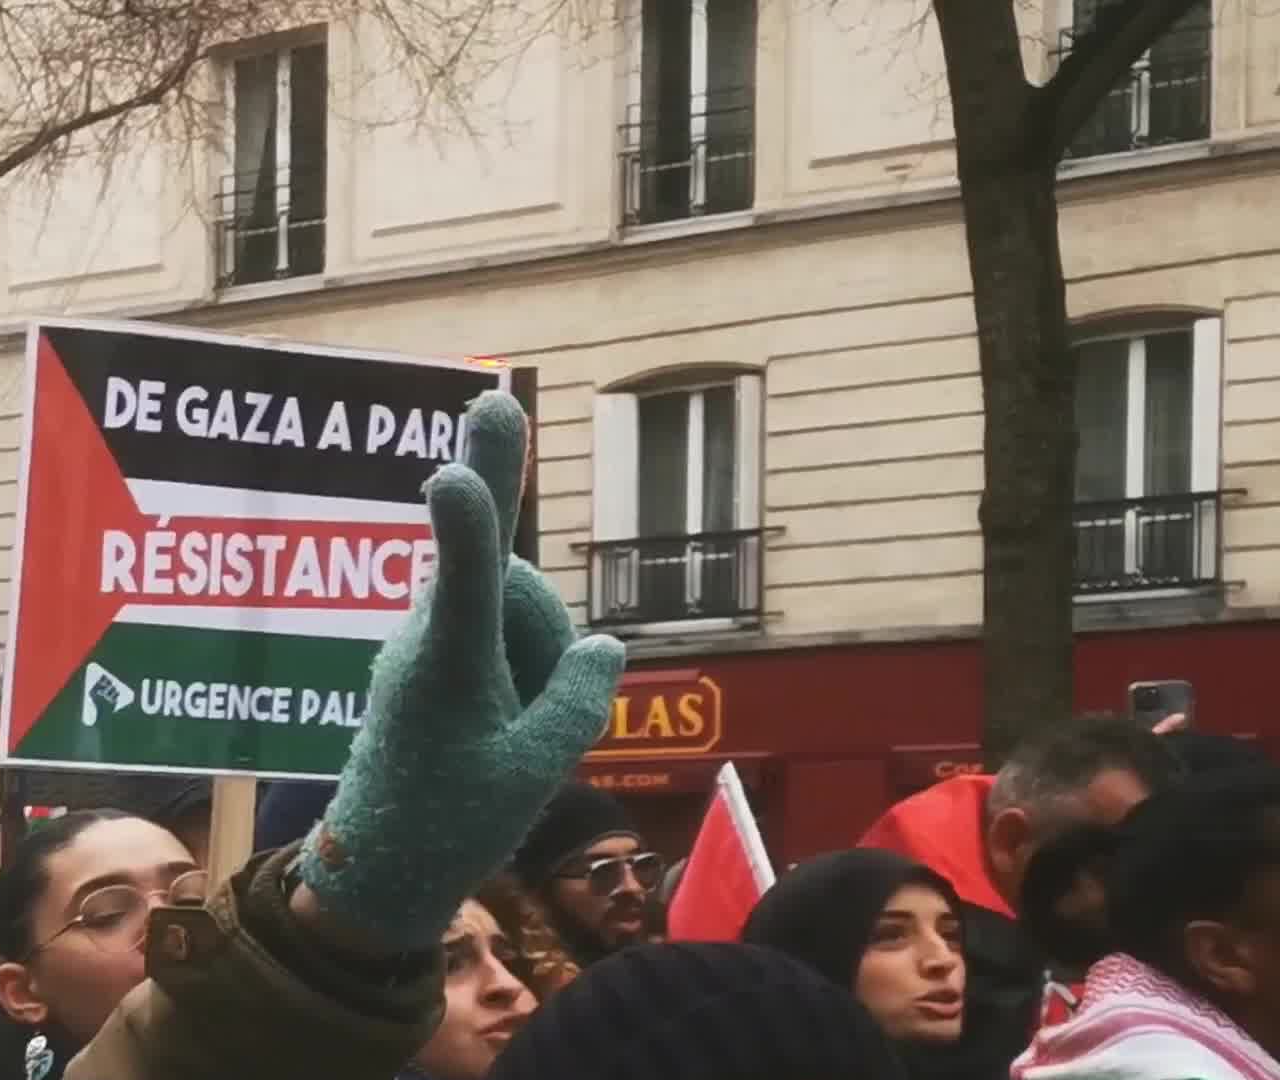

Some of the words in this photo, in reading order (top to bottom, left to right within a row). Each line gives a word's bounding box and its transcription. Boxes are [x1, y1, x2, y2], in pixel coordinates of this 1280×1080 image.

[104, 375, 166, 433] DE
[176, 385, 304, 449] GAZA
[316, 400, 353, 452] A
[366, 404, 467, 464] PARI
[141, 678, 292, 723] URGENCE
[299, 689, 363, 727] PAL
[611, 694, 704, 739] LAS
